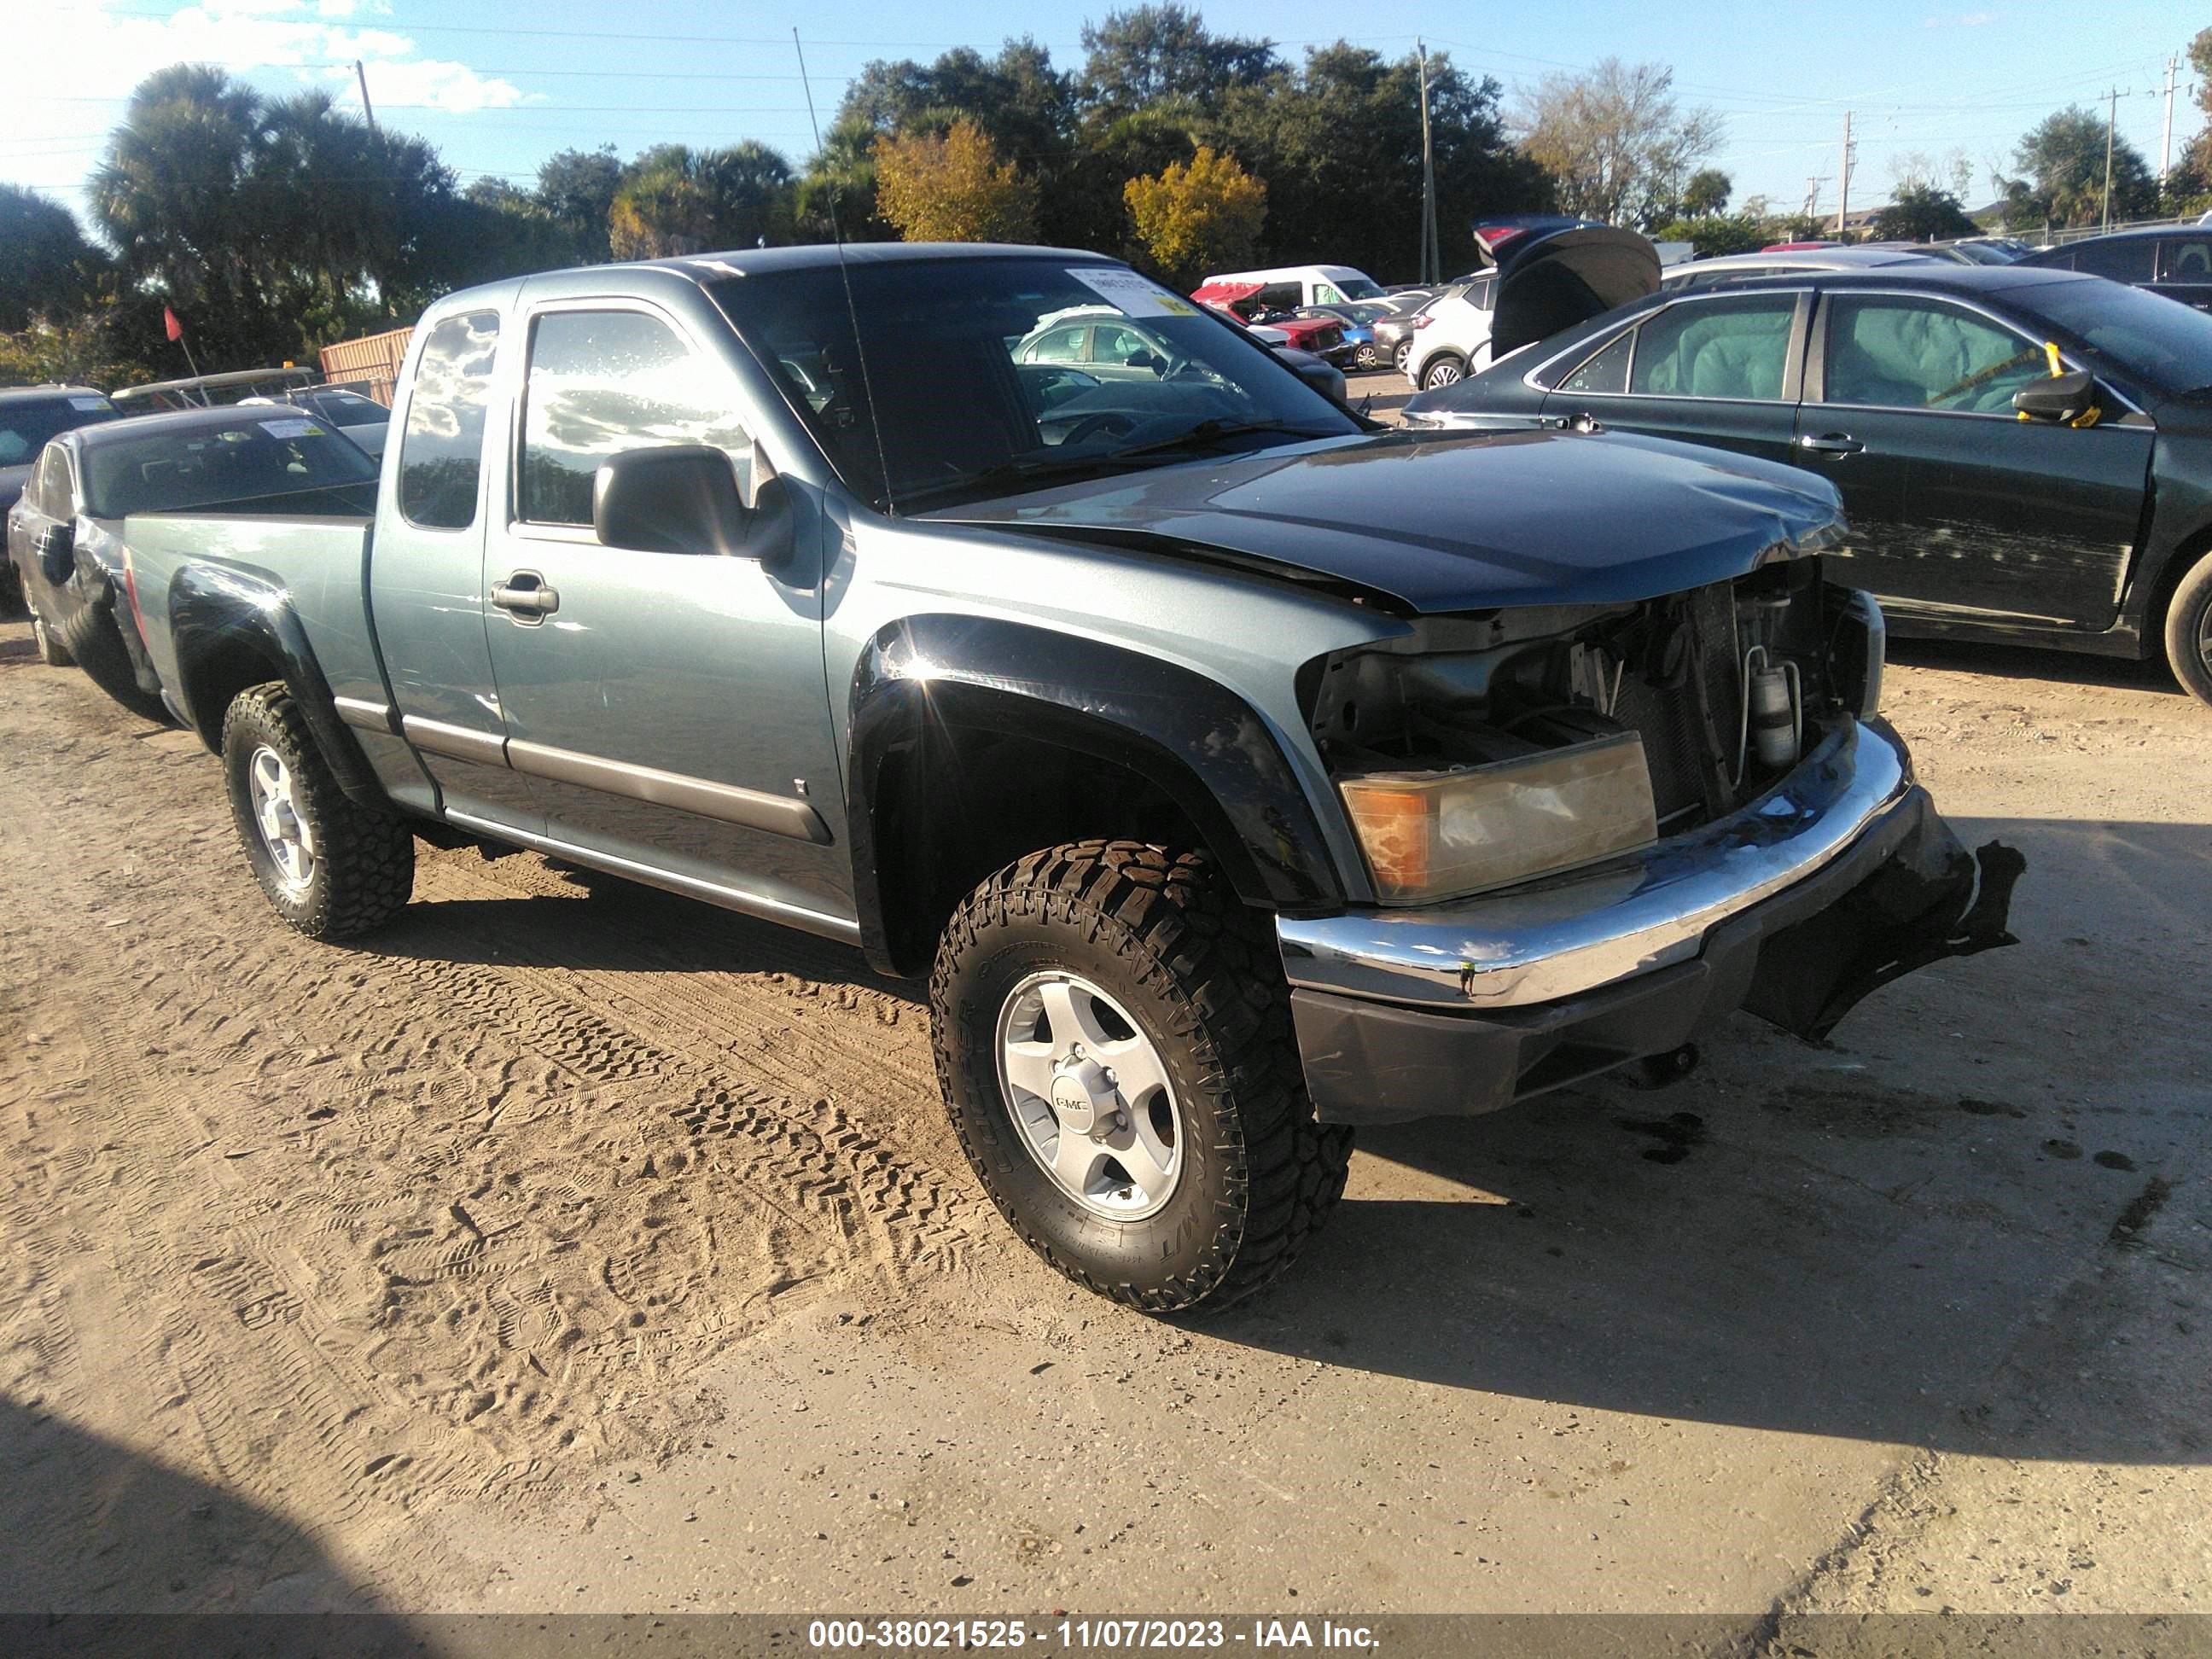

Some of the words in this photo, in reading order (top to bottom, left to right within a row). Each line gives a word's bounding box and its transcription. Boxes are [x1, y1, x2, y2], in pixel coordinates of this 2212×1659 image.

[957, 997, 1014, 1173] COOPER
[1056, 1097, 1089, 1111] GMC
[1158, 1201, 1200, 1265] M/T
